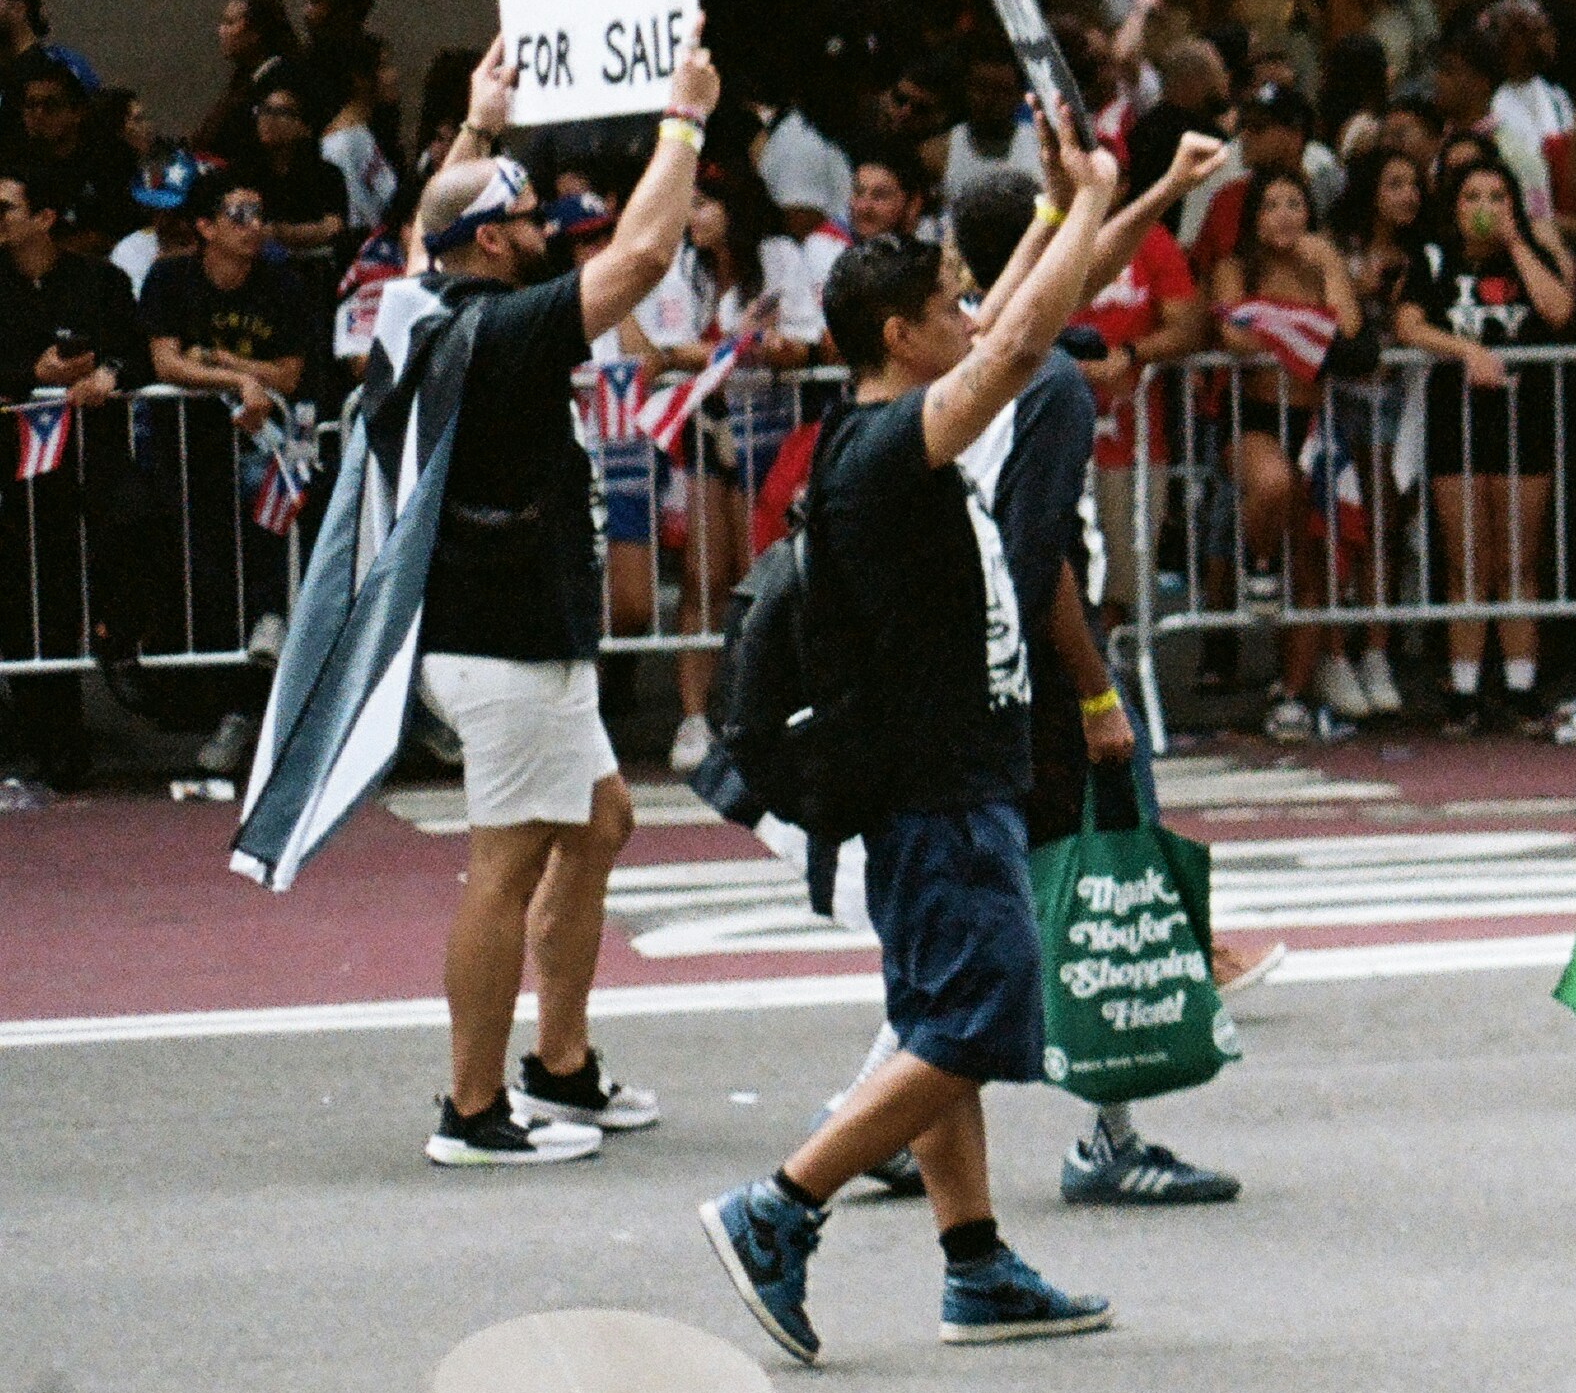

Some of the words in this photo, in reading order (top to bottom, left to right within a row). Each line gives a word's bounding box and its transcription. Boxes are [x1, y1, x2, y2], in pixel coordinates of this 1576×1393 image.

[513, 29, 574, 91] FOR
[602, 8, 684, 85] SALE
[1075, 865, 1181, 918] Thank
[1068, 918, 1135, 954] You
[1059, 948, 1208, 999] Shopping
